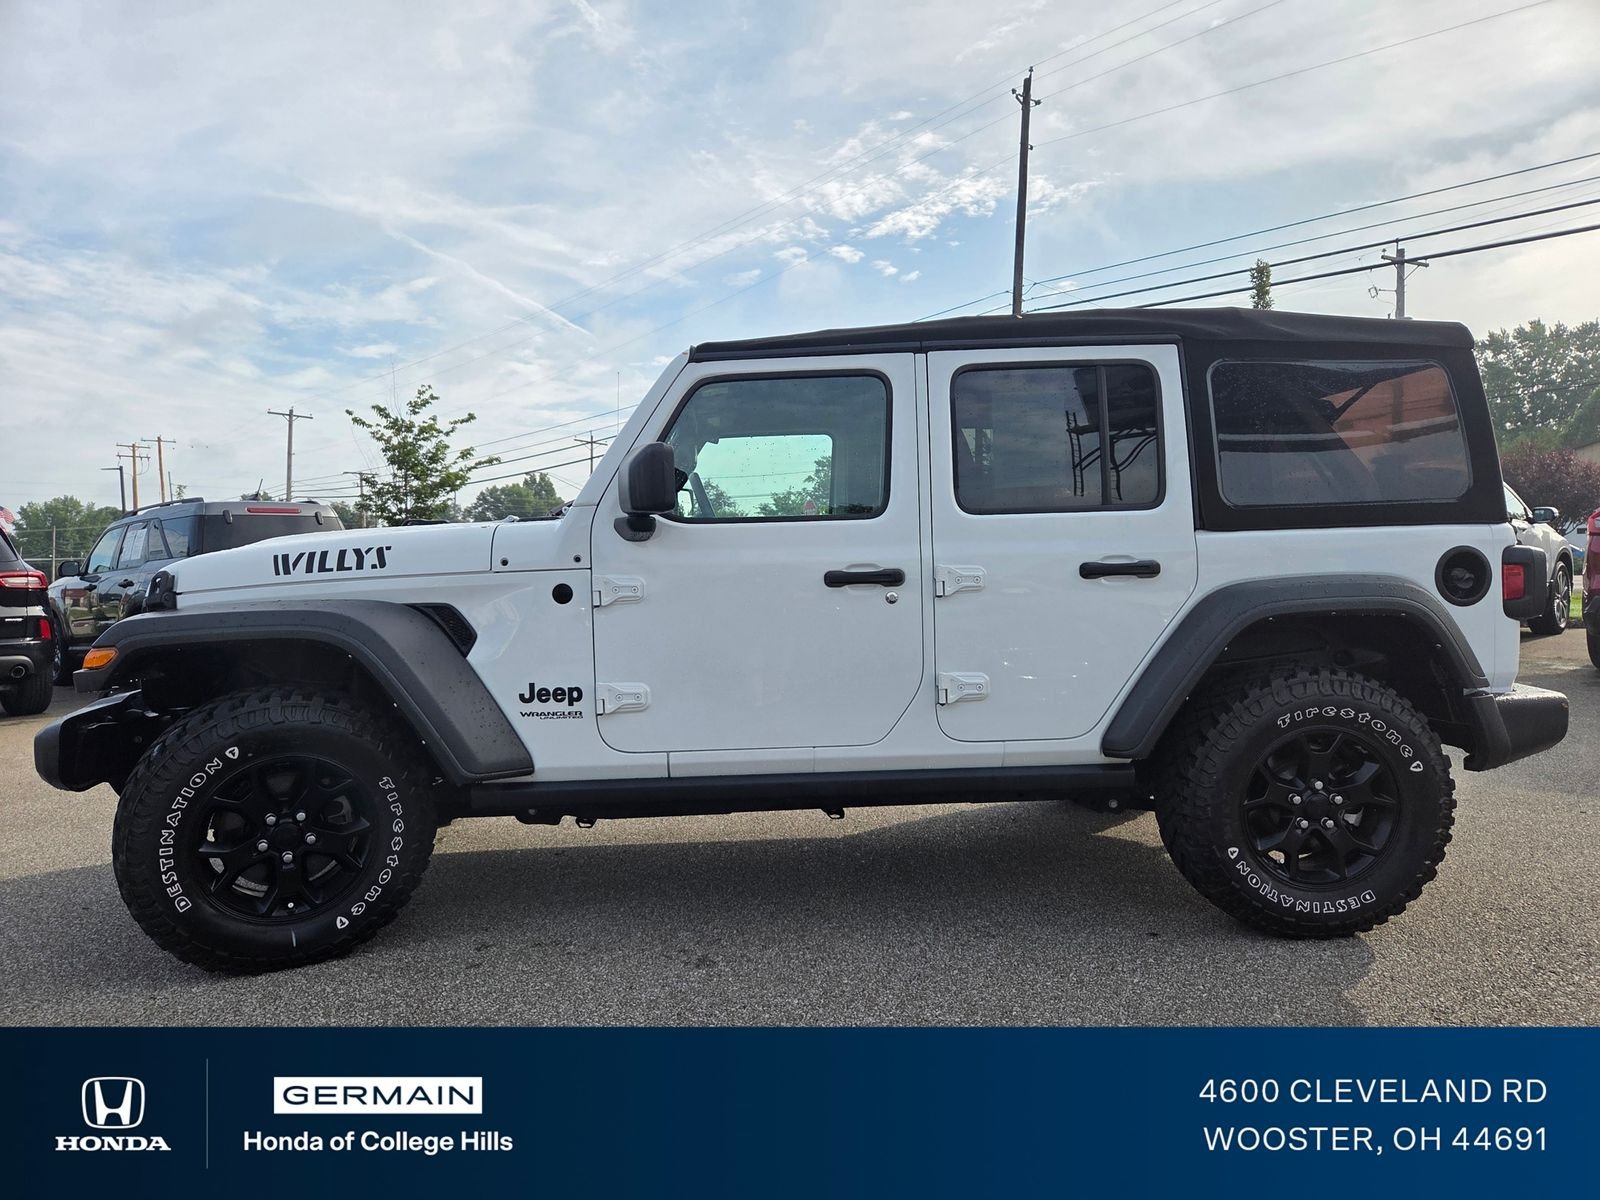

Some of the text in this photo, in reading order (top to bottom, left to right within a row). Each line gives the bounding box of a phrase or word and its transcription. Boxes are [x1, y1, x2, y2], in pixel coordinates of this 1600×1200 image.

[273, 546, 392, 576] WILLYS
[519, 682, 583, 707] Jeep
[1277, 706, 1413, 758] Firestone
[159, 757, 223, 912] DESTINATION
[351, 776, 404, 915] Firestone
[1236, 861, 1376, 914] DESTINATION
